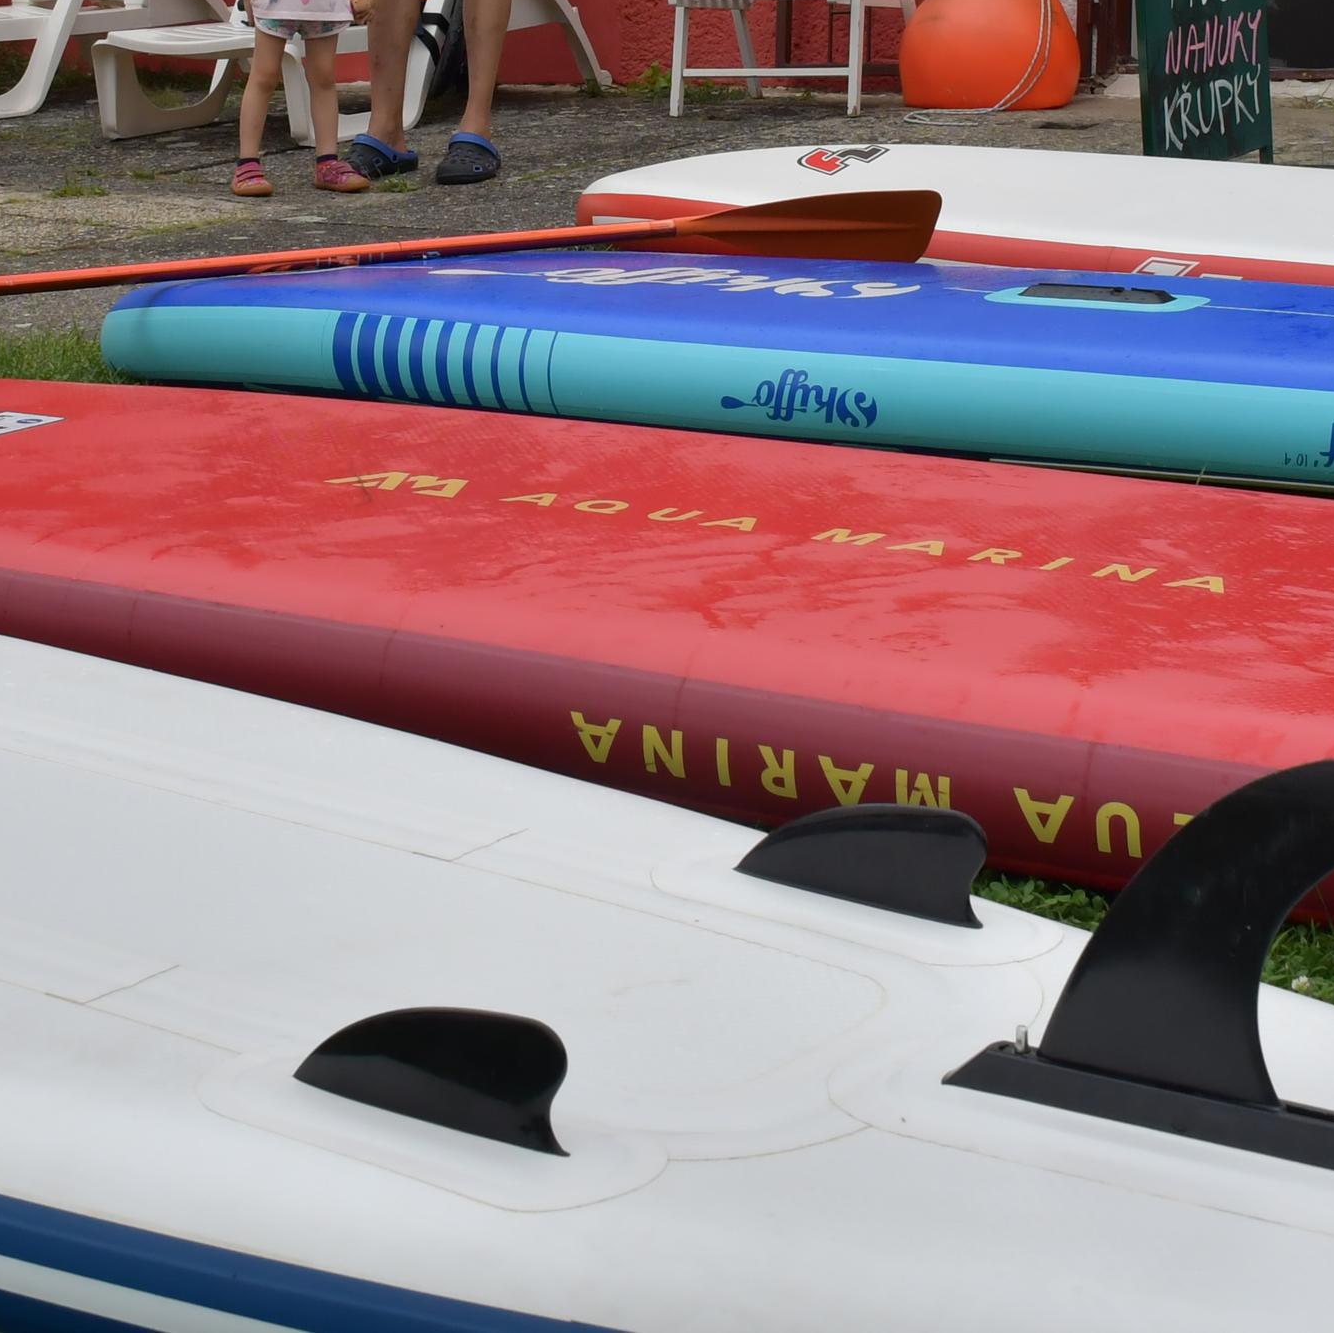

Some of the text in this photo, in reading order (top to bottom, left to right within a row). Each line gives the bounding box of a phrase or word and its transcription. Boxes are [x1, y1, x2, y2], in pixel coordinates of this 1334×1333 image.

[1165, 9, 1261, 74] NANUKY
[1164, 63, 1261, 151] KŘUPKY
[499, 490, 757, 533] AQUA
[810, 526, 1227, 595] MARINA
[568, 710, 951, 812] MARINA
